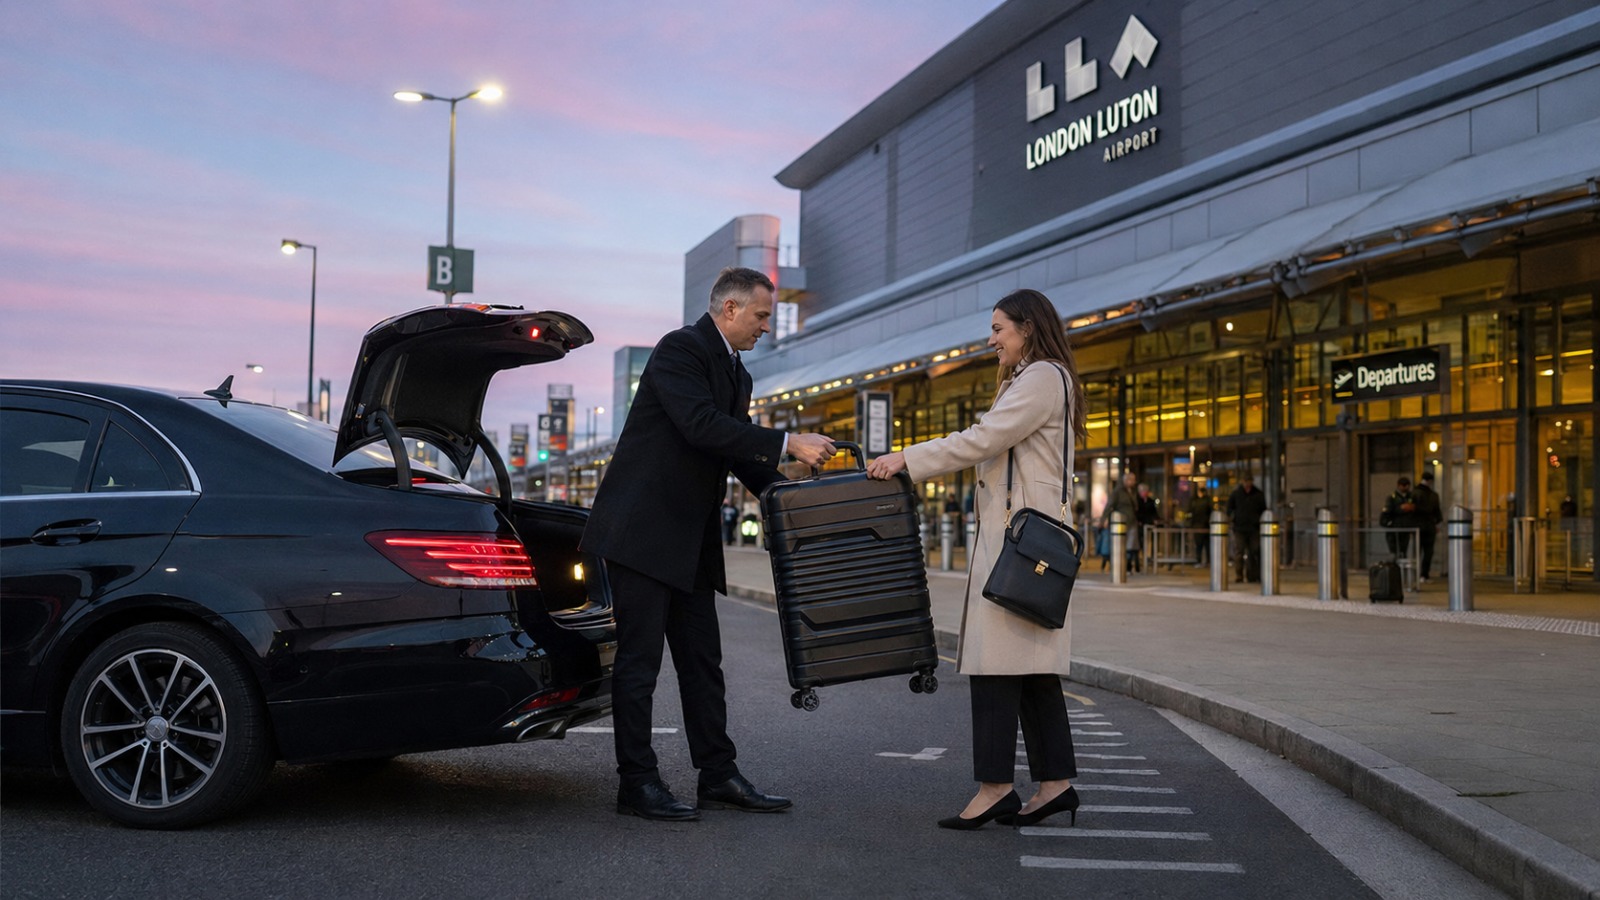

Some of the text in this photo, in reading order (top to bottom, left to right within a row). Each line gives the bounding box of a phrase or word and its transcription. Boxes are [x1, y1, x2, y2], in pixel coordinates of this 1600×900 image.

[1026, 85, 1157, 170] LONDON LUTON
[1103, 127, 1157, 162] AIRPORT
[436, 255, 453, 285] B
[1357, 362, 1436, 392] Departures
